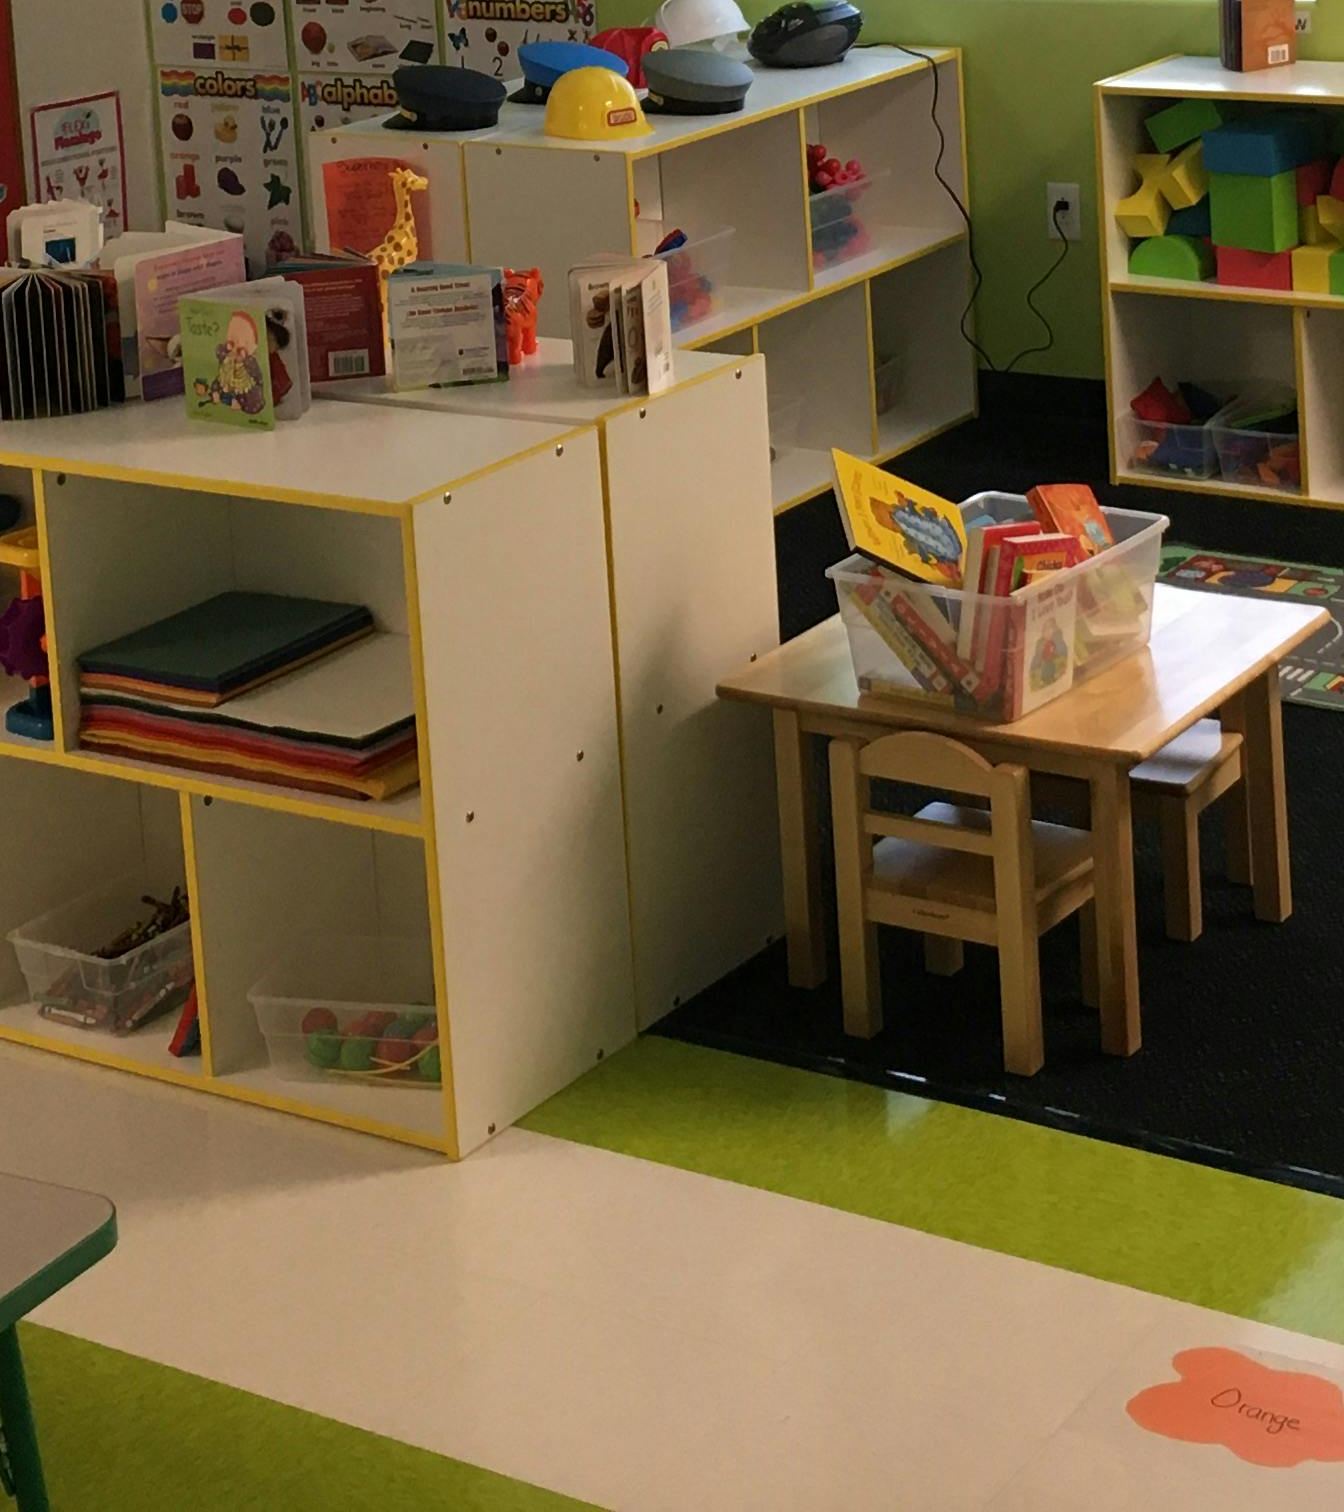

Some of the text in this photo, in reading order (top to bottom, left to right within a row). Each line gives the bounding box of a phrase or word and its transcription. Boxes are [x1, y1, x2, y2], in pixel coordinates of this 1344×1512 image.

[492, 56, 503, 77] 2
[194, 71, 256, 98] colors
[322, 78, 399, 111] alphab
[215, 155, 242, 164] purple
[176, 209, 205, 219] brown
[1210, 1387, 1303, 1435] Orange
